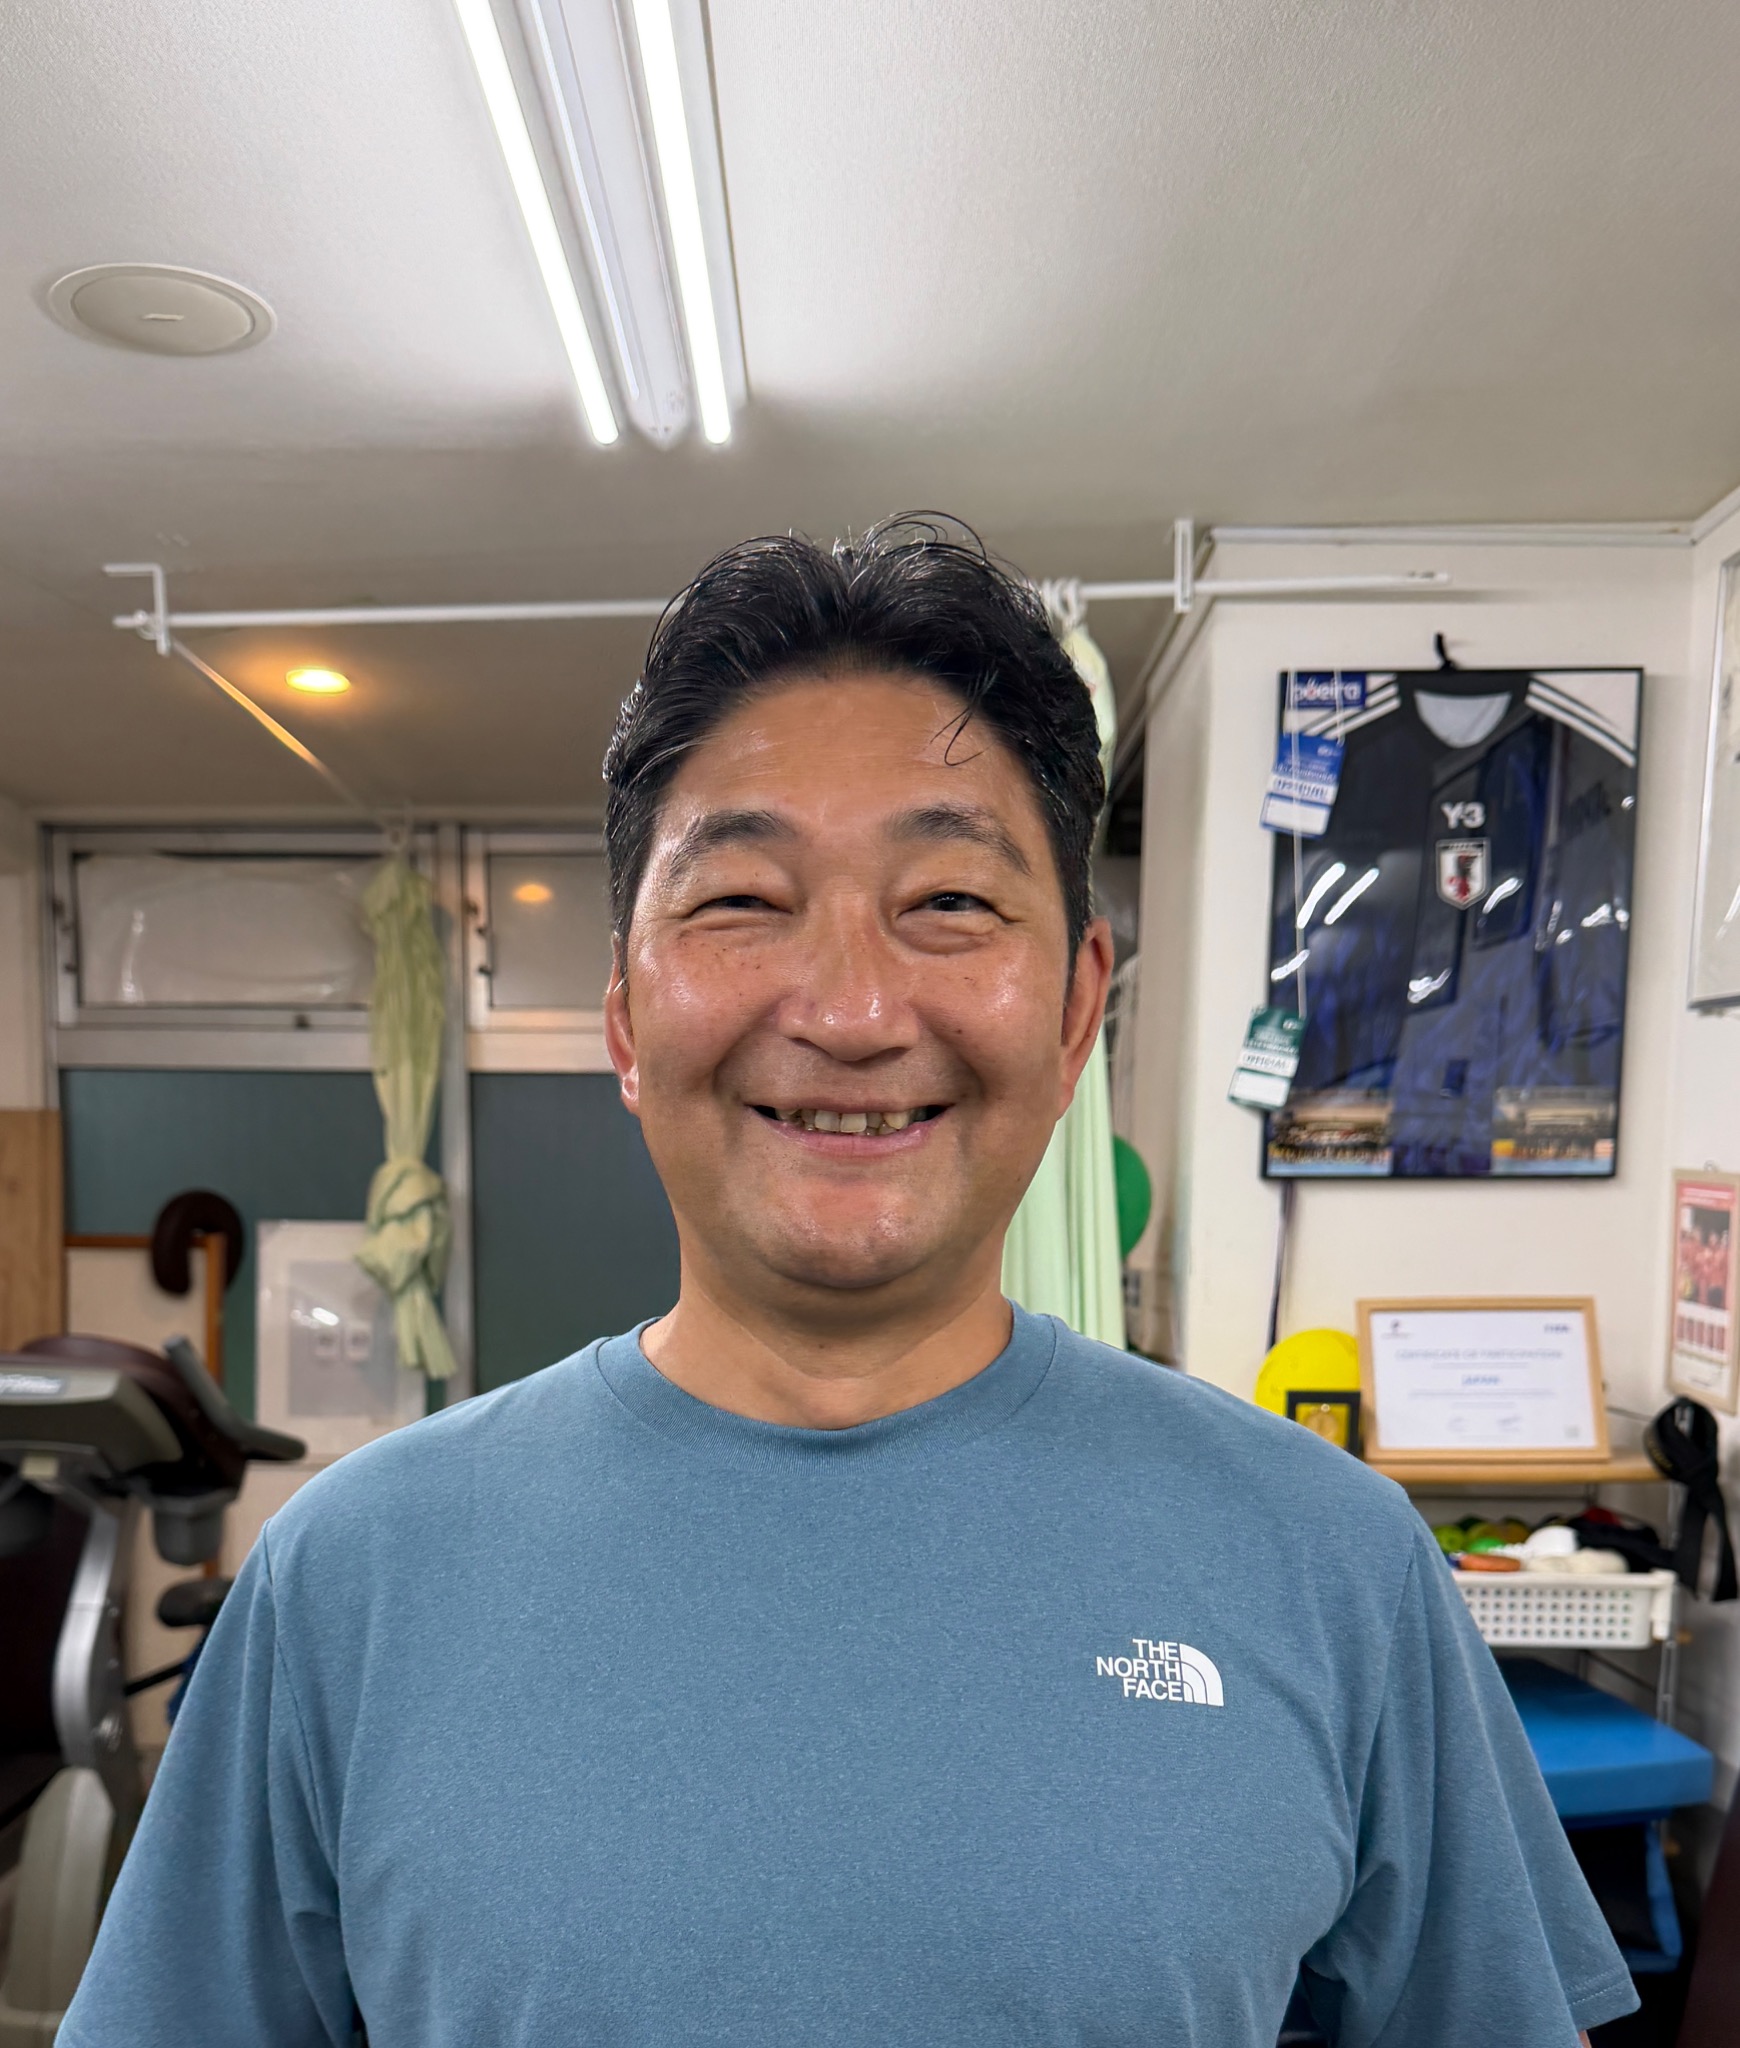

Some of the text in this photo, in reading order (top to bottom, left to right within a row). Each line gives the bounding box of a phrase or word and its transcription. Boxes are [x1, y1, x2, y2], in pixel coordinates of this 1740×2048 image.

[1441, 802, 1486, 829] Y-3
[1132, 1638, 1179, 1661] THE
[1096, 1656, 1181, 1680] NORTH
[1123, 1678, 1183, 1701] FACE
